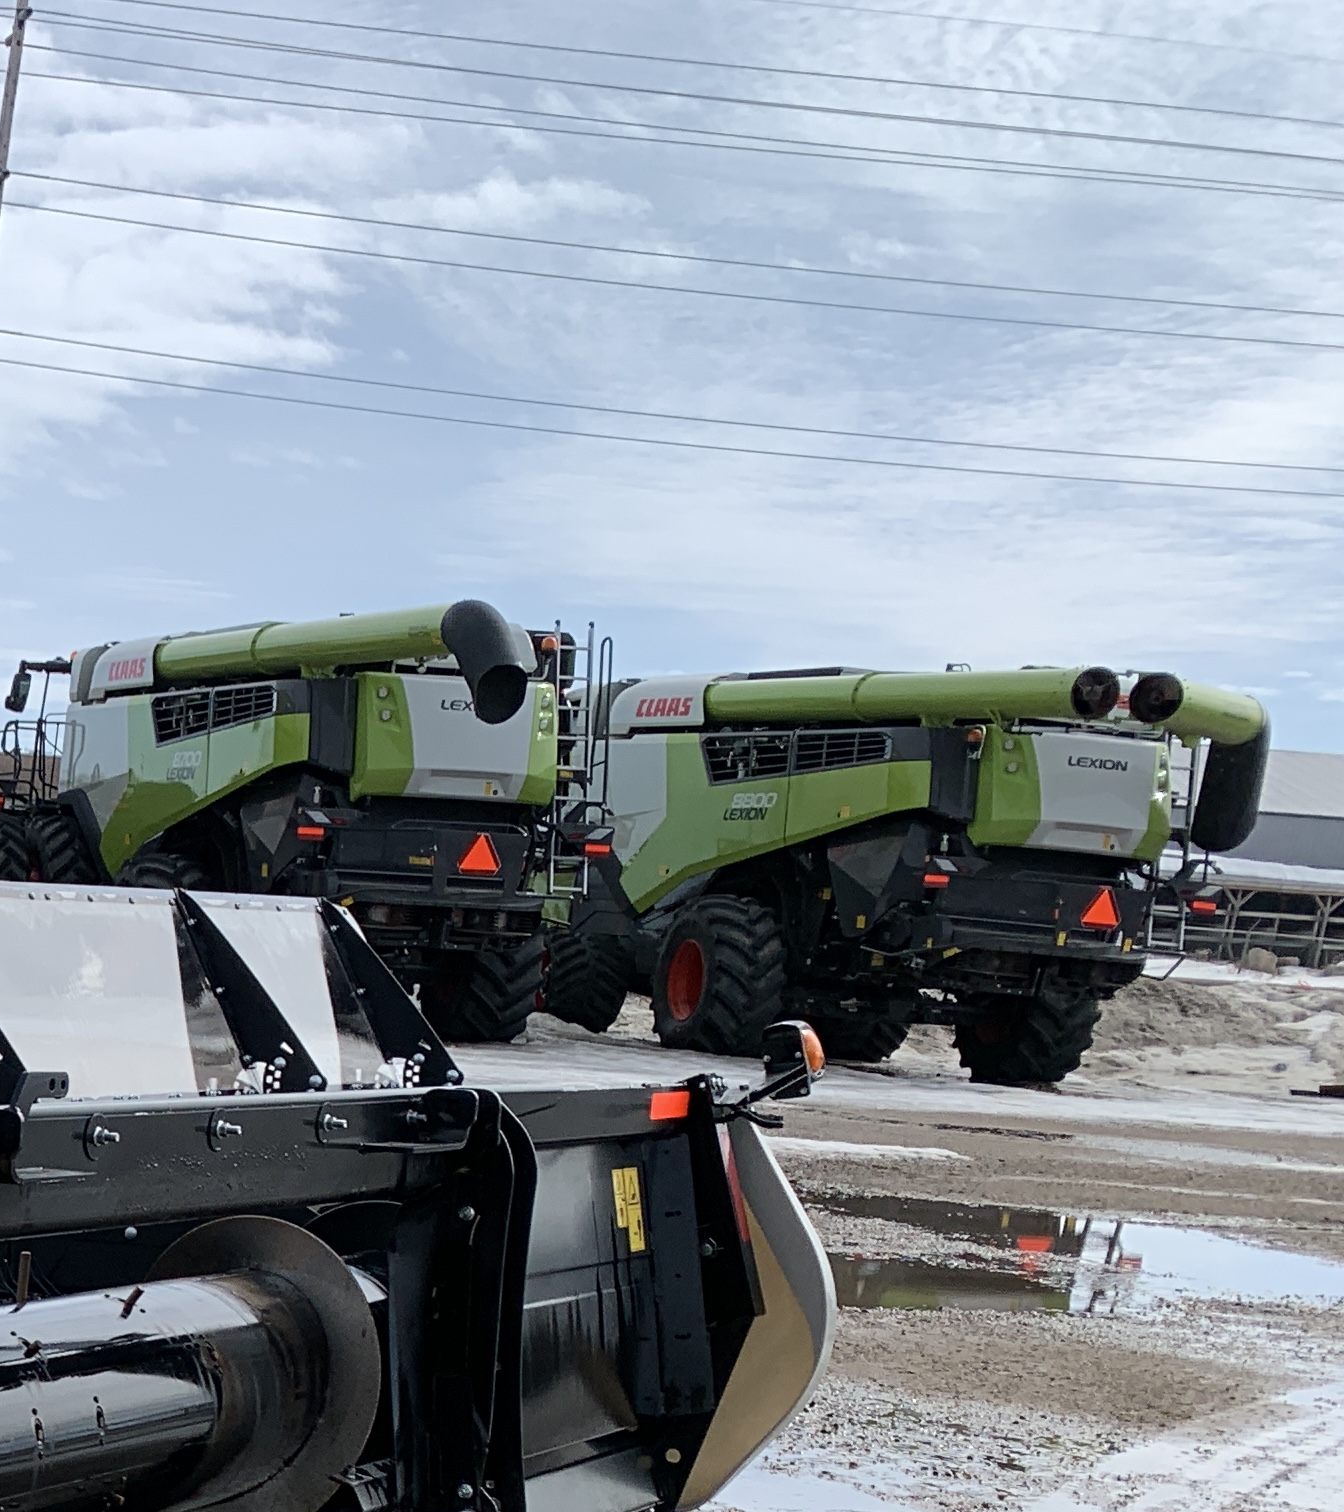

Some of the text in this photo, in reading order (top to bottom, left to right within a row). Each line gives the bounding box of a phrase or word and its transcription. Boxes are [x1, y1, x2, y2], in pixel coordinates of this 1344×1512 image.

[108, 658, 147, 682] CLAAS
[440, 699, 477, 712] LEX
[635, 697, 694, 718] CLAAS
[1067, 755, 1129, 772] LEXION
[731, 792, 778, 808] 8800
[722, 807, 768, 822] LEXION
